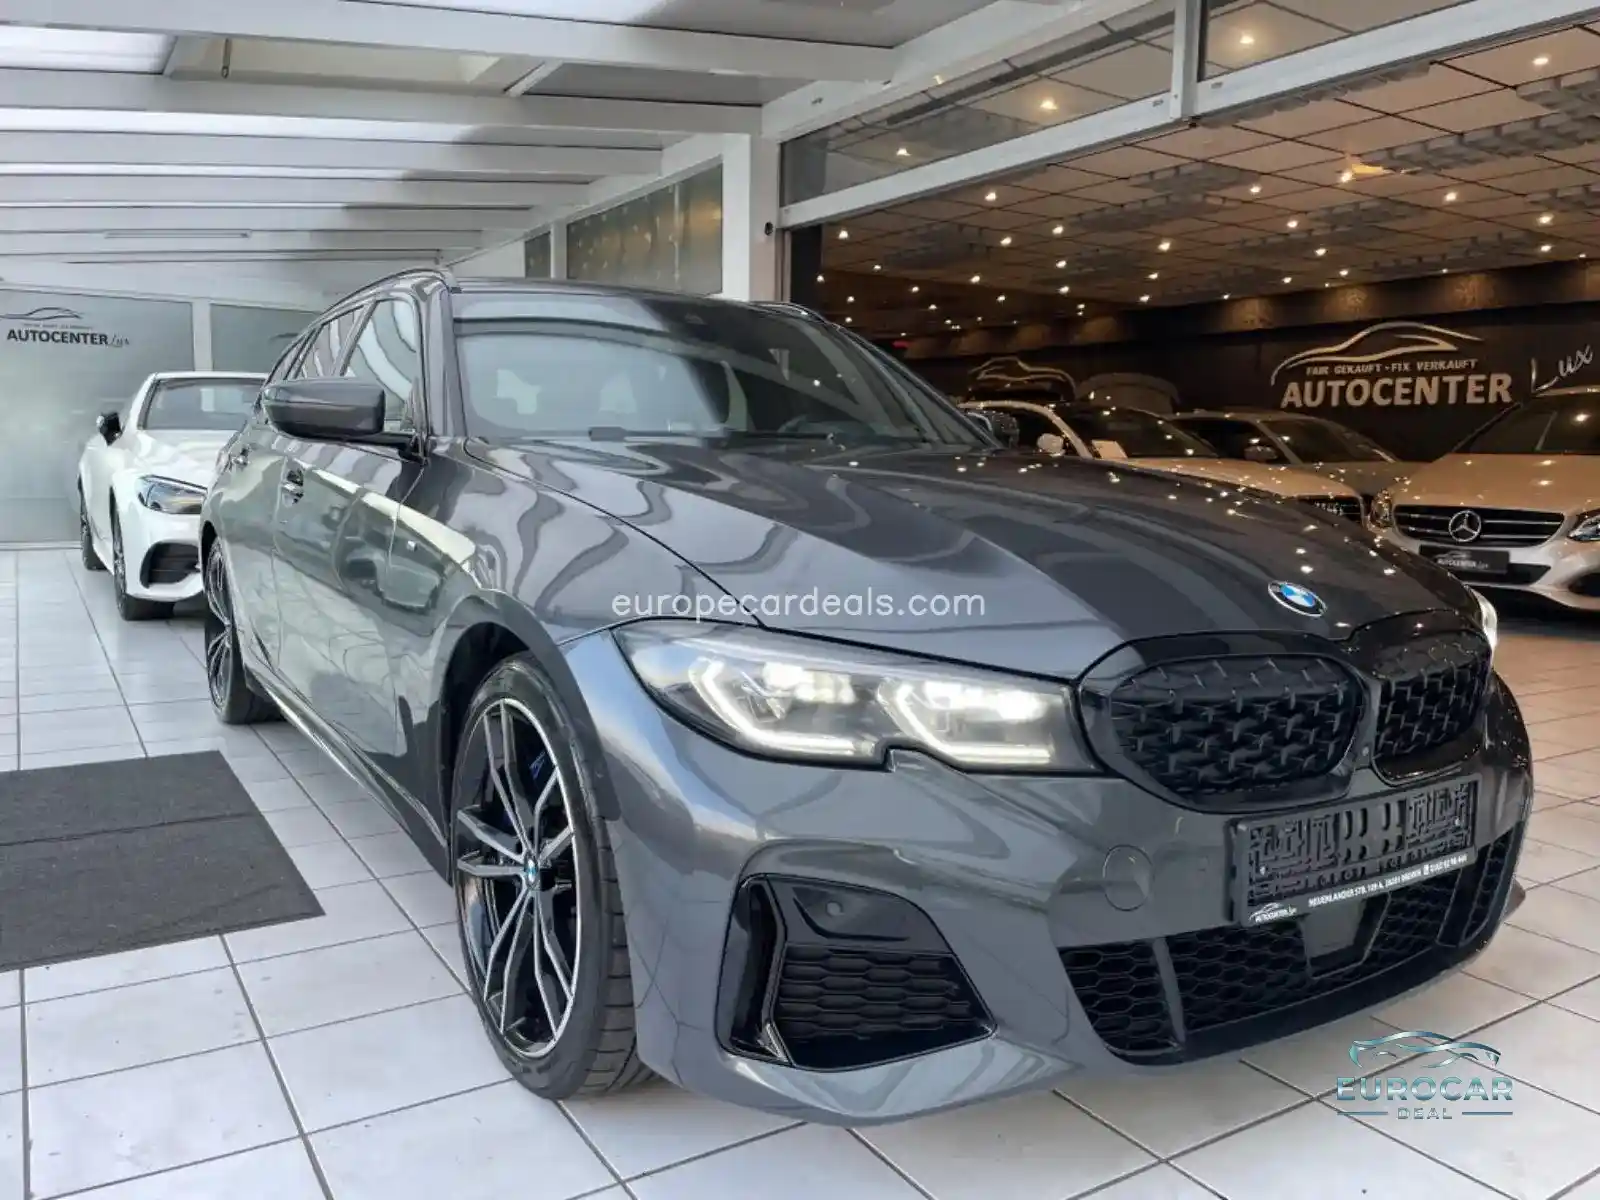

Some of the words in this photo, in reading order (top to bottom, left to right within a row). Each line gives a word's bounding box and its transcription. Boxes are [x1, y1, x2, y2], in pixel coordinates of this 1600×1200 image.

[7, 329, 108, 345] AUTOCENTER
[1416, 358, 1479, 372] VERKAUFT
[1280, 373, 1513, 409] AUTOCENTER
[1530, 343, 1594, 394] Lux
